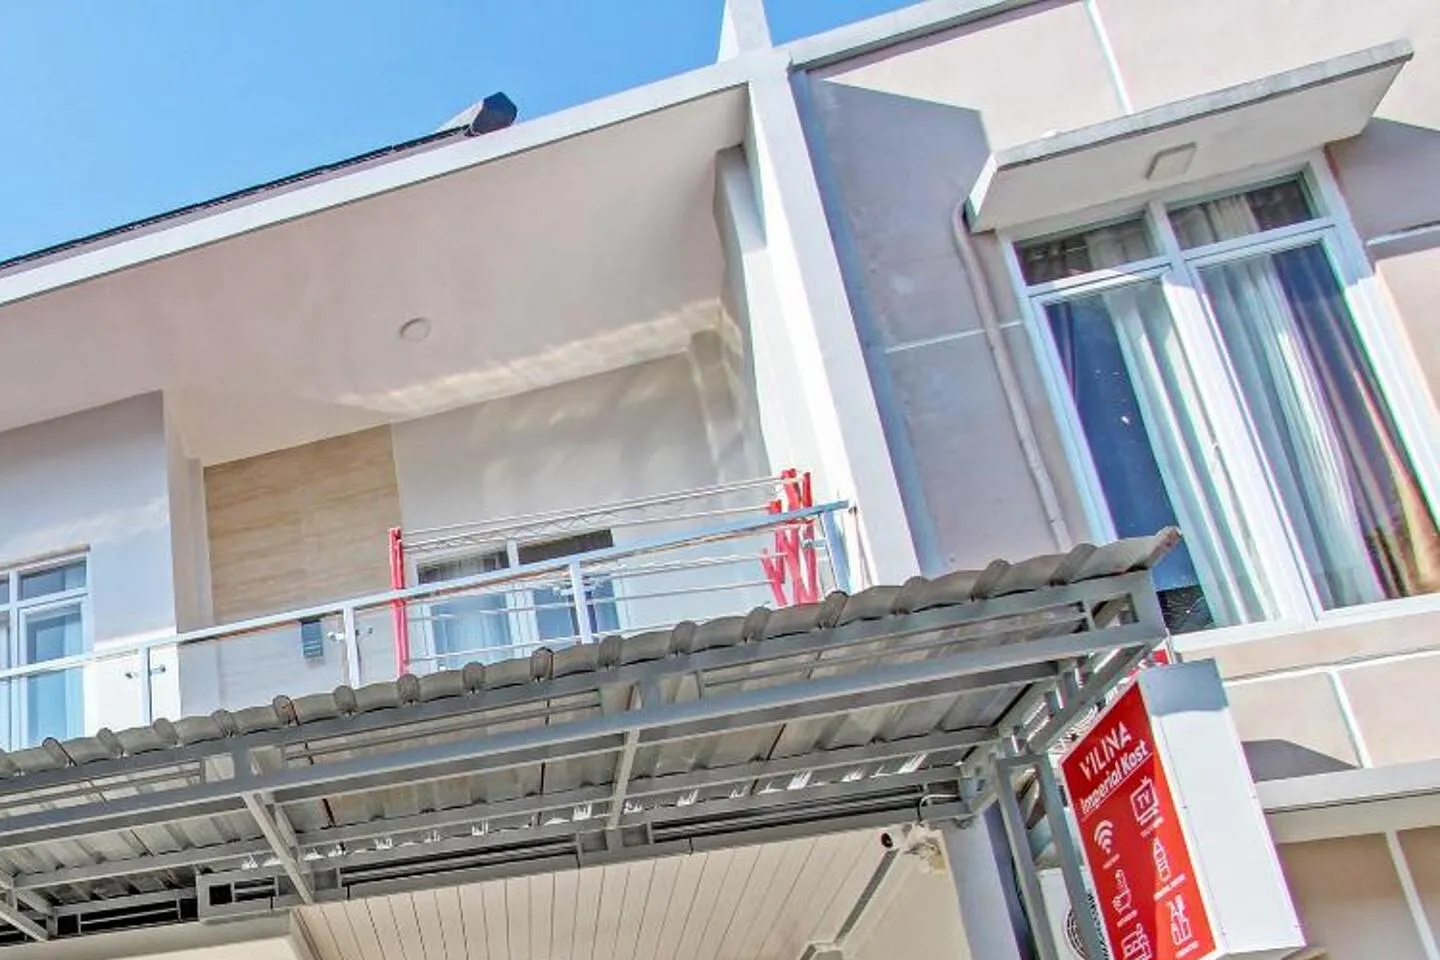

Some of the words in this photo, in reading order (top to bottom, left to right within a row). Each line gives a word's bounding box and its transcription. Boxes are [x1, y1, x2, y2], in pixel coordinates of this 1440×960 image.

[1079, 720, 1132, 781] VILINA
[1080, 761, 1122, 816] Imperial
[1120, 739, 1149, 776] Kost
